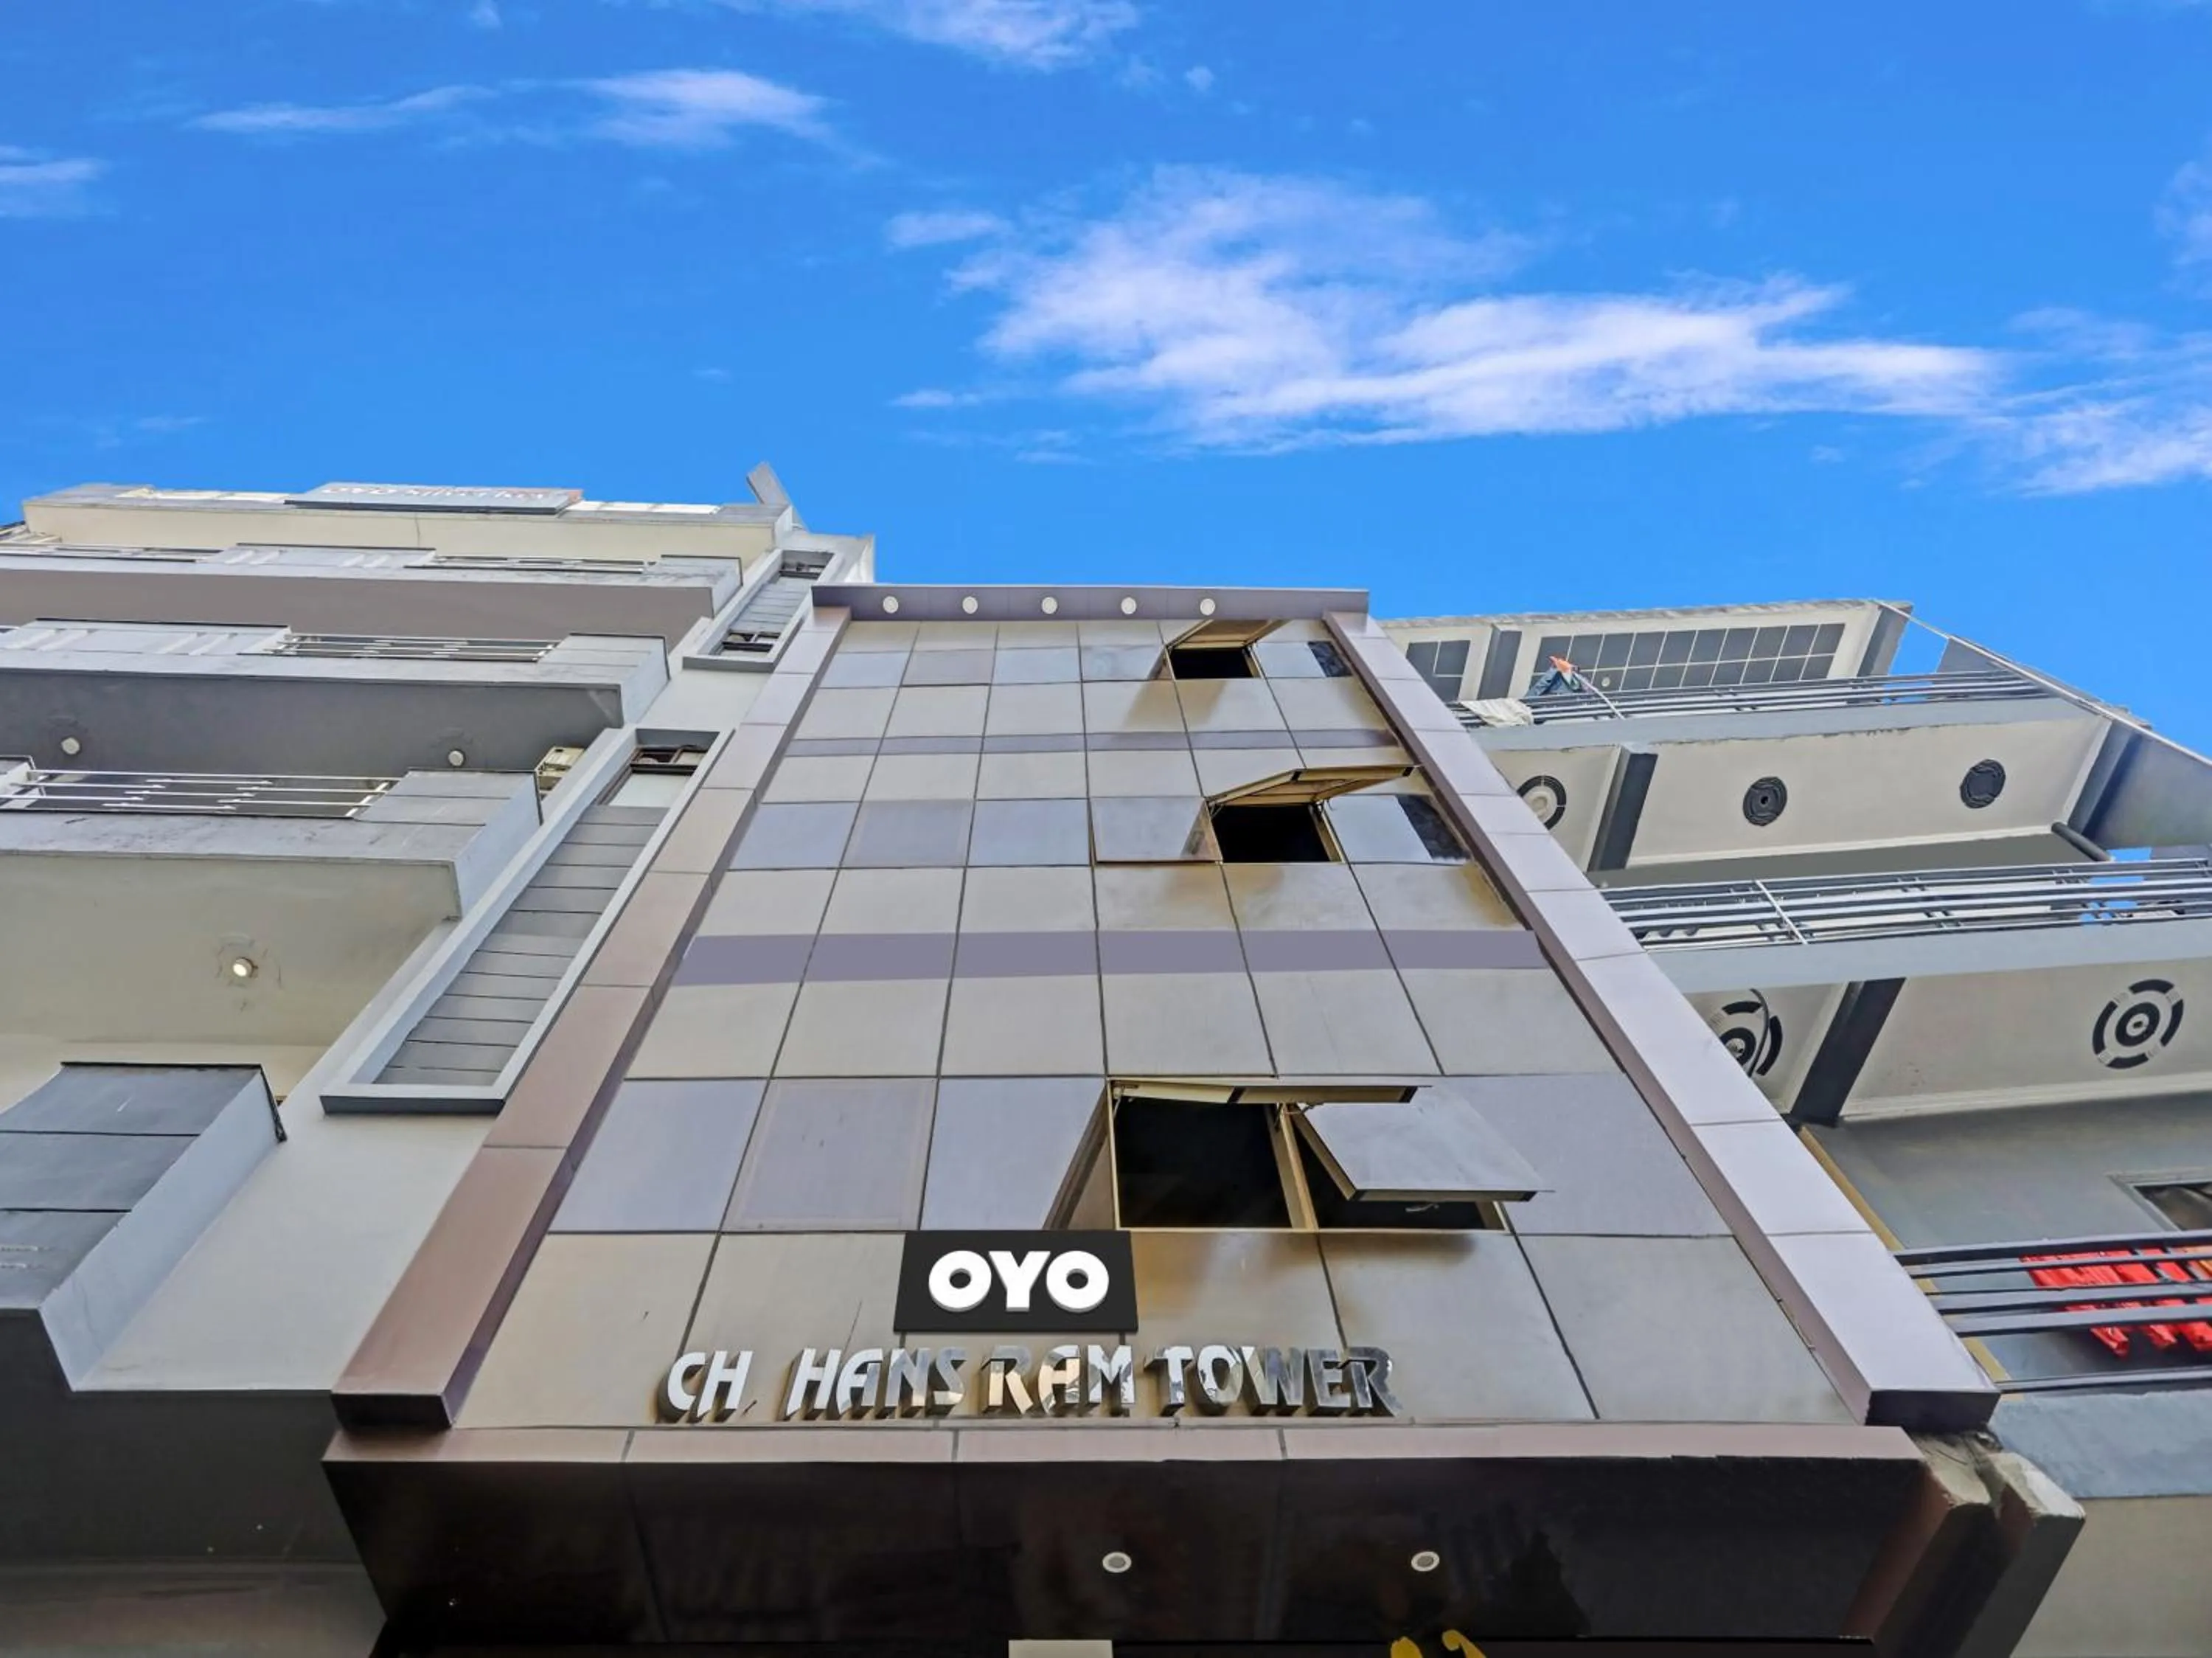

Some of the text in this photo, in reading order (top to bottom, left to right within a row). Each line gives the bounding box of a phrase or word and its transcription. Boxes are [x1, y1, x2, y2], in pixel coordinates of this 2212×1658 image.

[928, 1250, 1110, 1313] OYO
[785, 1347, 967, 1415] HANS
[980, 1345, 1136, 1415] RAM
[1144, 1345, 1404, 1417] TOWER
